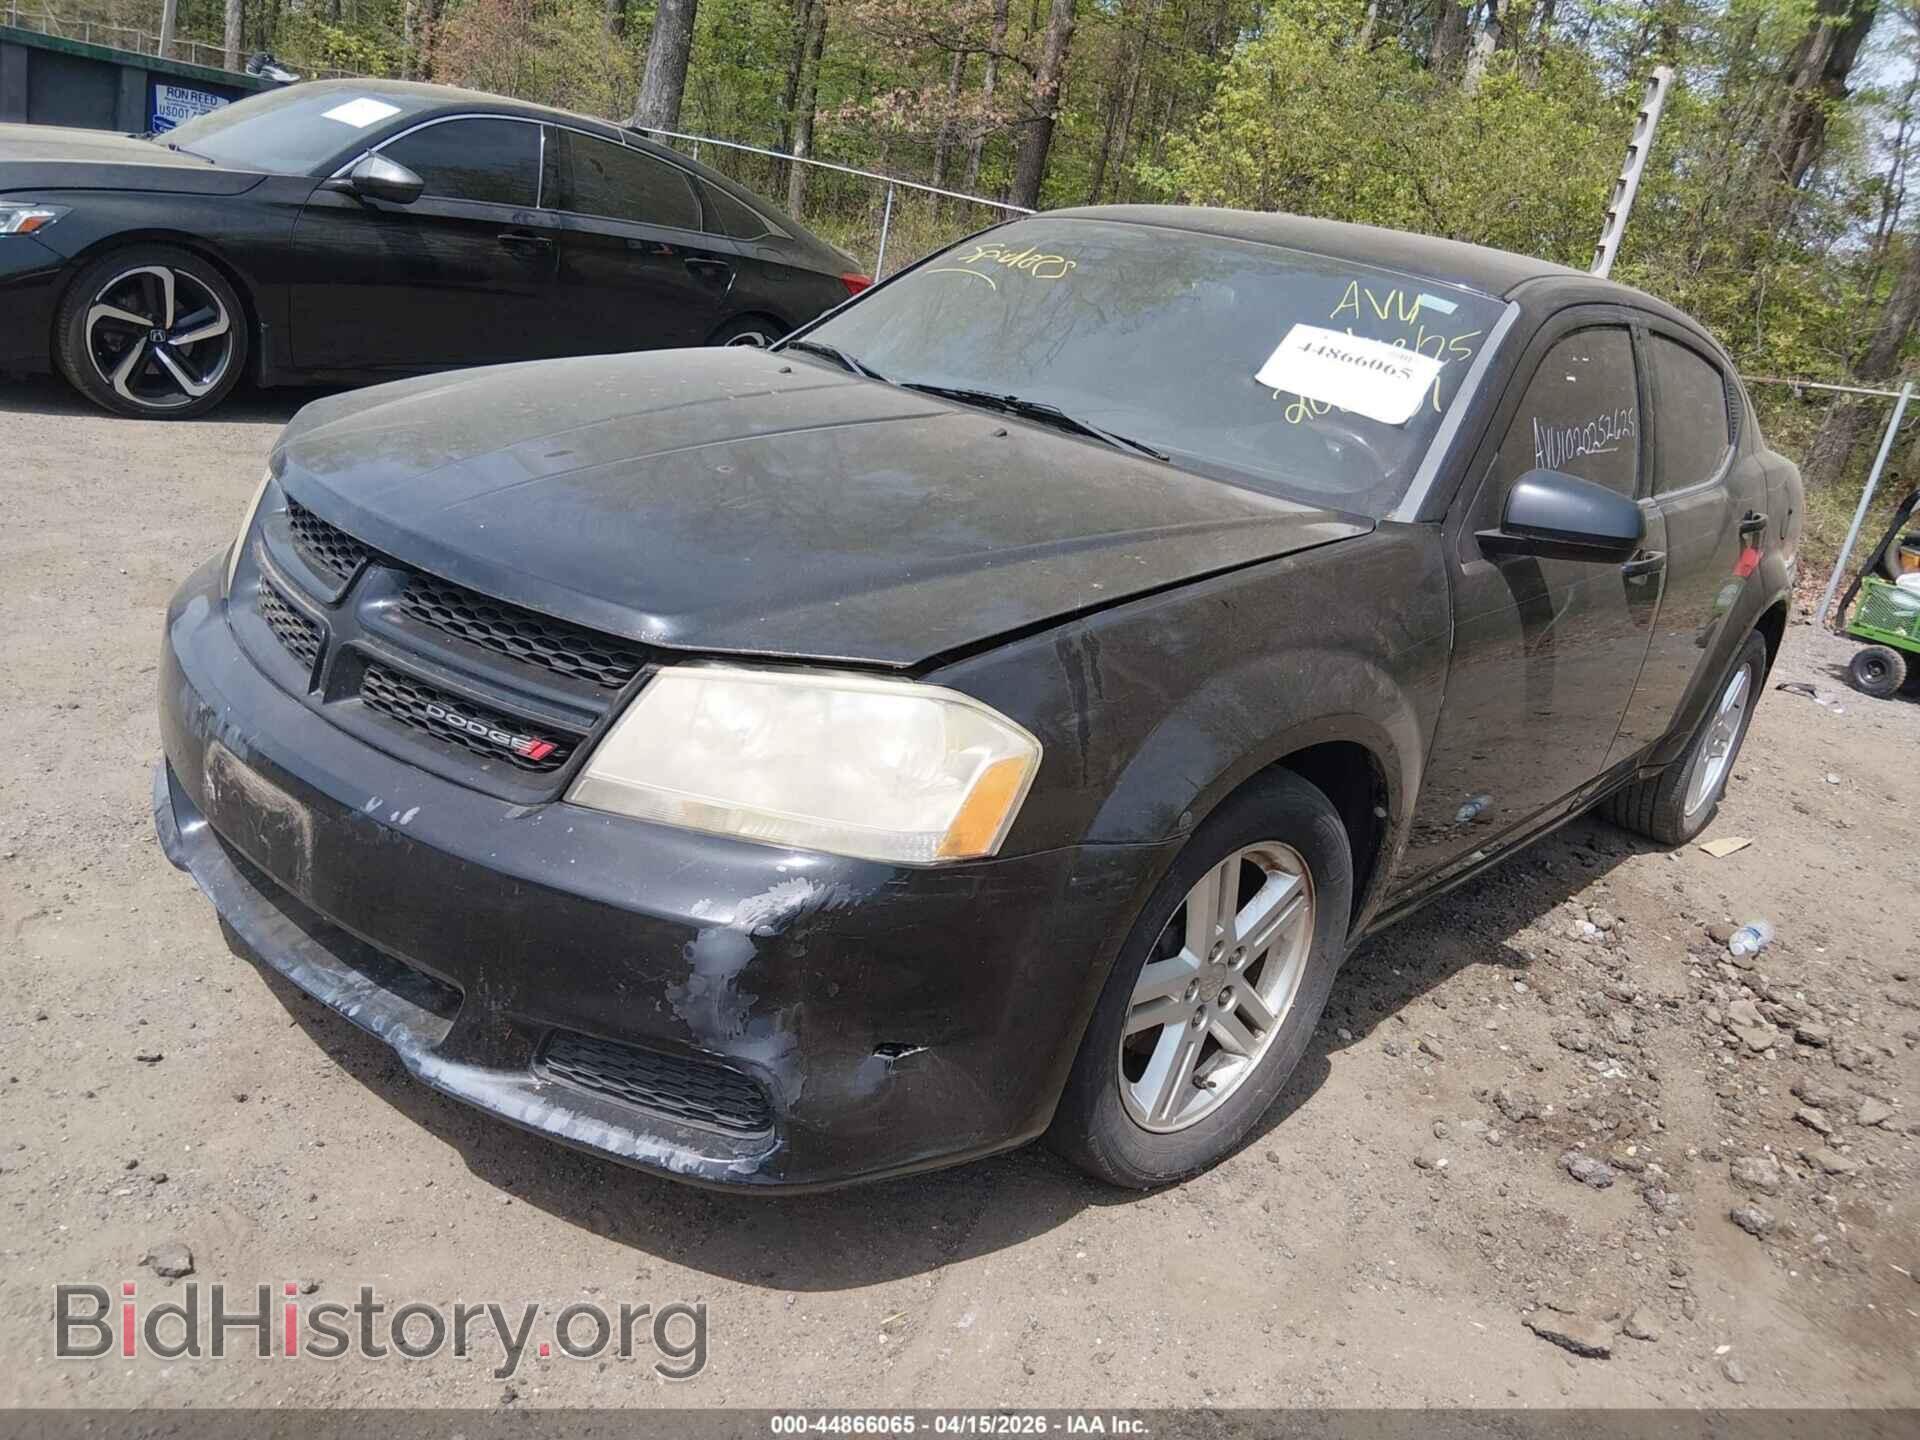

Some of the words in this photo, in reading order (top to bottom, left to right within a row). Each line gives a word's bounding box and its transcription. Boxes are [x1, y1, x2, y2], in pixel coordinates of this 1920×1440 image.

[167, 86, 189, 100] RON
[190, 91, 218, 106] REED
[426, 703, 533, 753] DODGE
